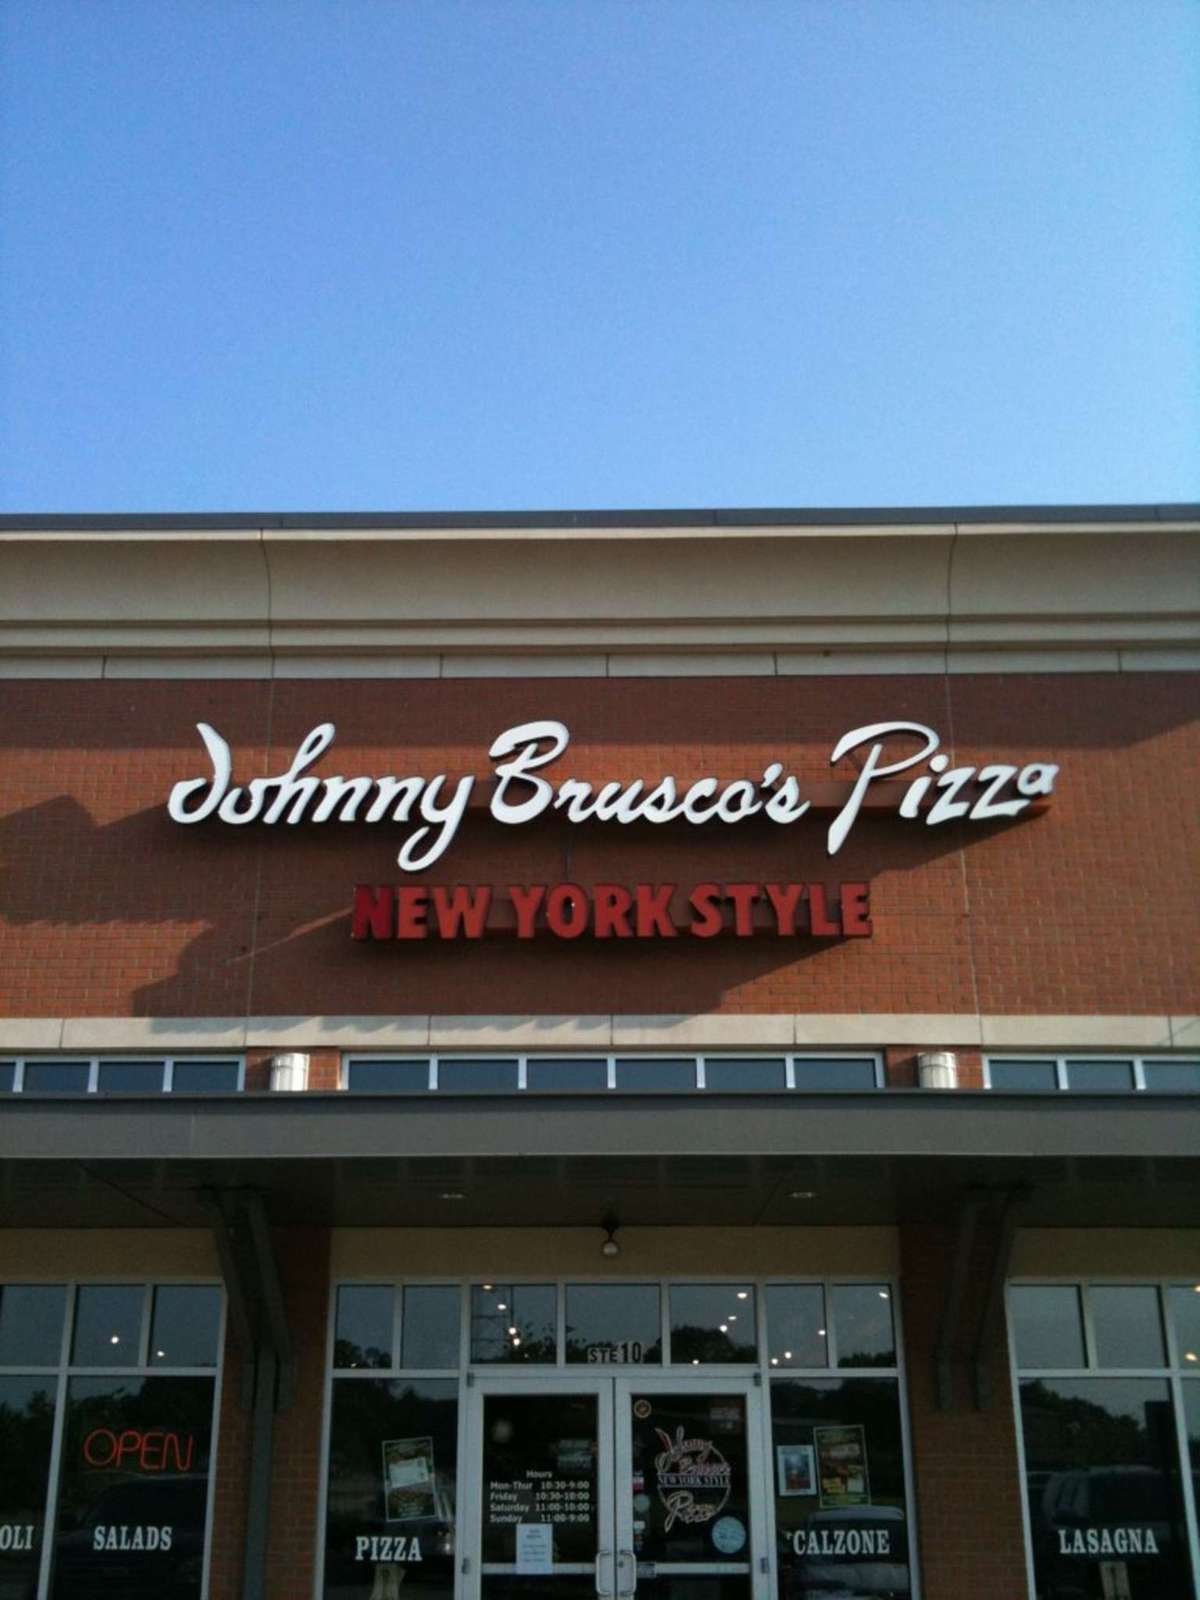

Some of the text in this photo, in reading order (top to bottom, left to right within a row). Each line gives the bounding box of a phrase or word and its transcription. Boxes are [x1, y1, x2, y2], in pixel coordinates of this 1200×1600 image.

[168, 720, 1060, 872] Johnny Brusco's Pizza
[351, 881, 873, 940] NEW YORK STYLE
[590, 1342, 642, 1362] STE 10
[83, 1428, 194, 1471] OPEN
[526, 1471, 553, 1479] Hours
[489, 1492, 518, 1502] Friday
[489, 1503, 530, 1513] Saturday
[489, 1514, 523, 1524] Sunday
[0, 1524, 35, 1550] OLI
[93, 1526, 173, 1550] SALADS
[355, 1536, 423, 1562] PIZZA
[793, 1530, 891, 1555] CALZONE
[1058, 1528, 1160, 1555] LASAGNA
